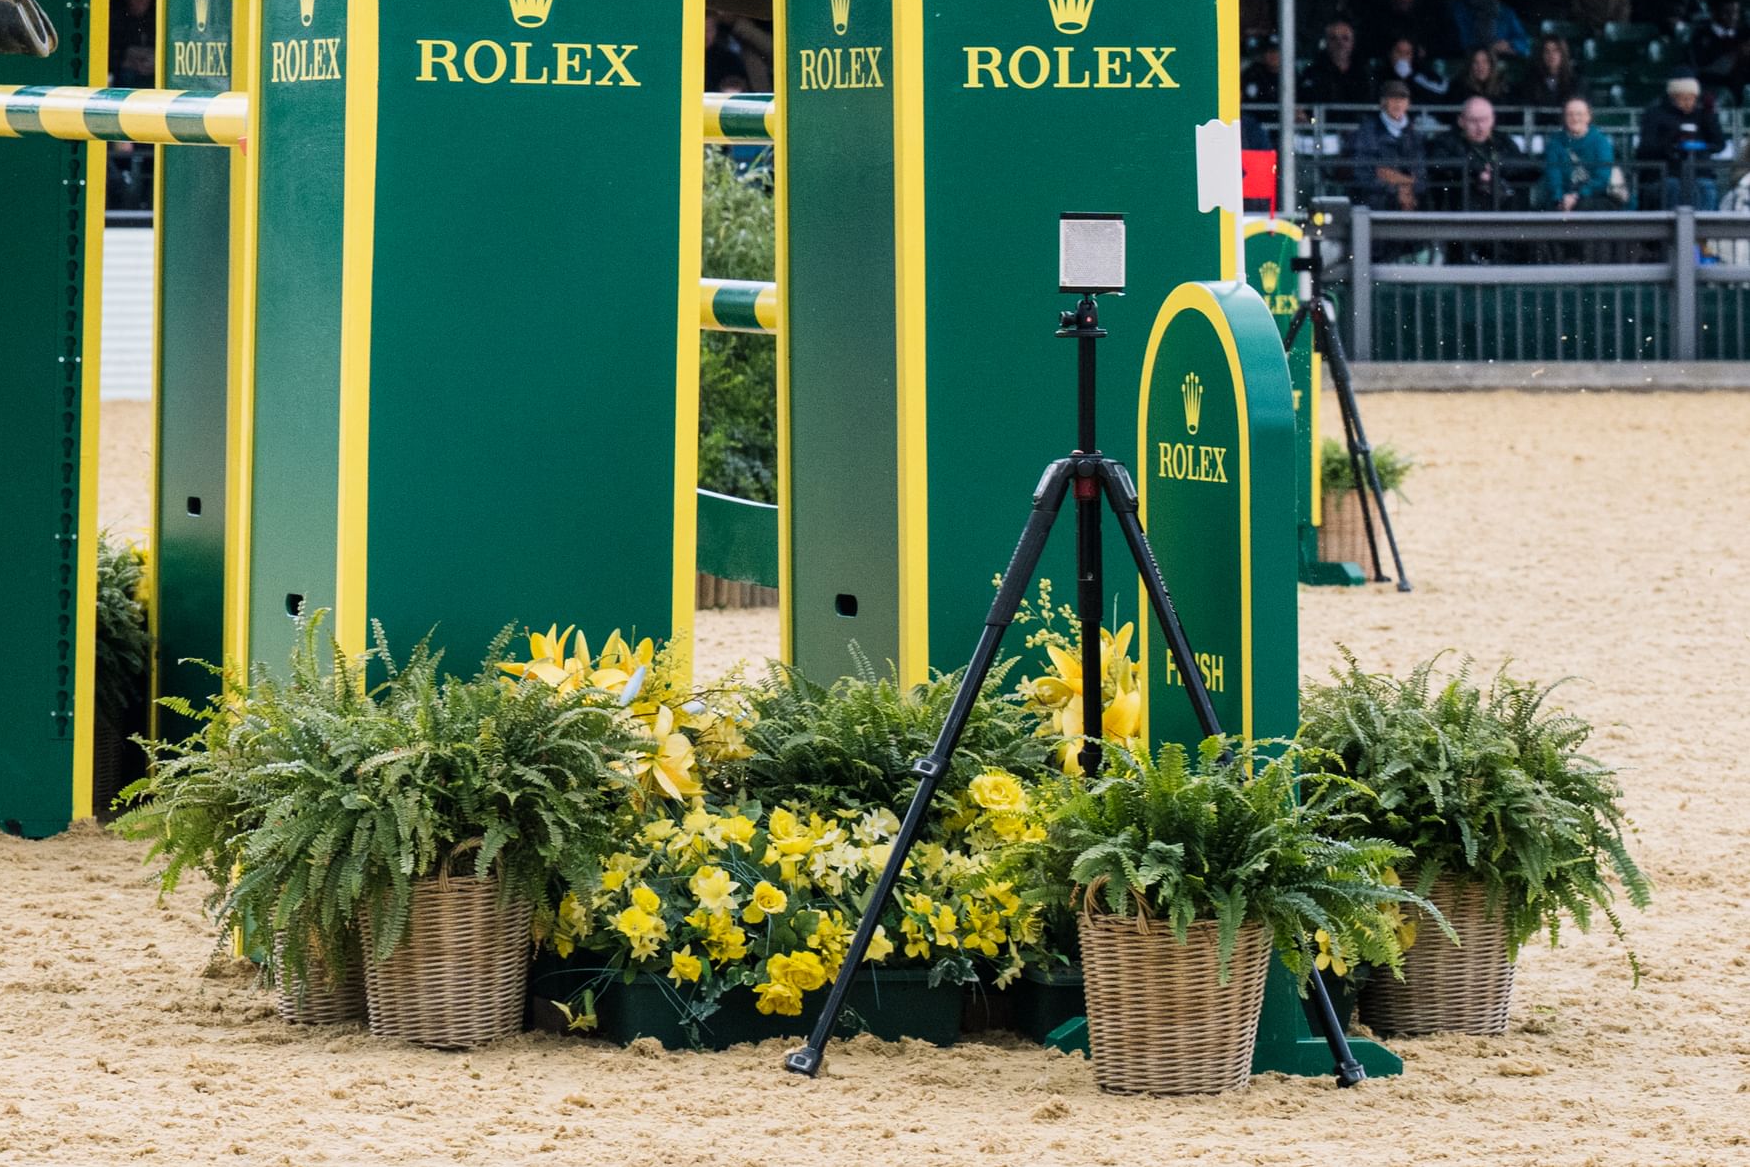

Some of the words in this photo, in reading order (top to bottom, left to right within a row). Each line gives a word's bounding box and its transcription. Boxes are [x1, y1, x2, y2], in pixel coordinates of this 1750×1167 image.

[174, 41, 228, 76] ROLEX
[271, 38, 342, 82] ROLEX
[415, 39, 642, 86] ROLEX
[799, 46, 885, 90] ROLEX
[962, 45, 1181, 89] ROLEX
[1264, 294, 1300, 315] LEX
[1158, 442, 1228, 483] ROLEX
[1166, 648, 1224, 692] FSH
